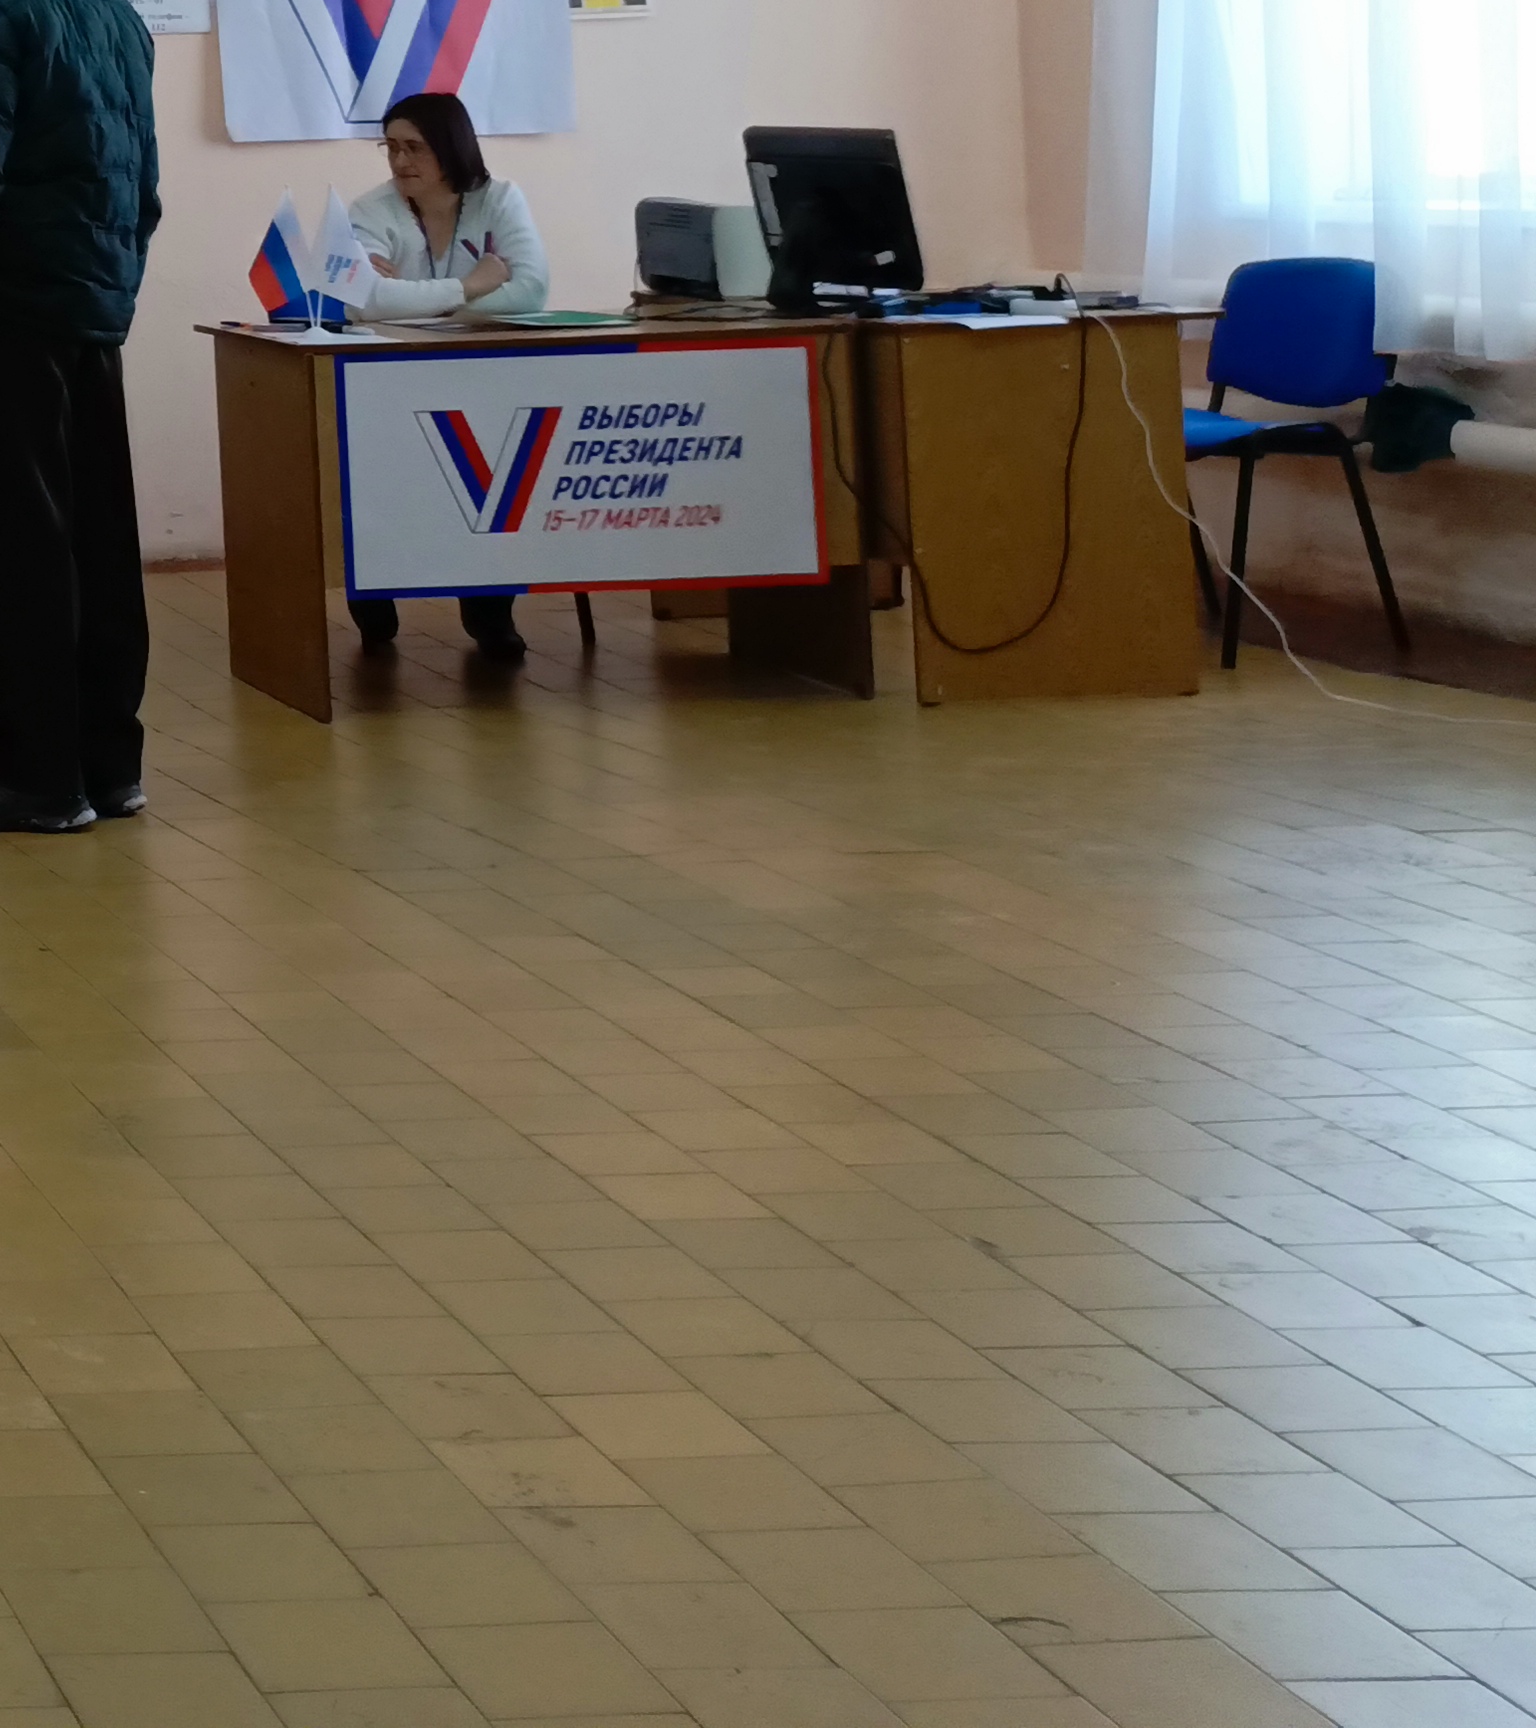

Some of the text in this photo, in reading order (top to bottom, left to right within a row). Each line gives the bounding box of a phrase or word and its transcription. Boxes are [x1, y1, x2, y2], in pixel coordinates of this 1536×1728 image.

[577, 401, 706, 430] ВЫБОРЫ
[564, 435, 743, 466] ПРЕЗИДЕНТА
[552, 473, 669, 501] РОССИИ
[543, 504, 722, 532] 15–17 МАРТА 2024
